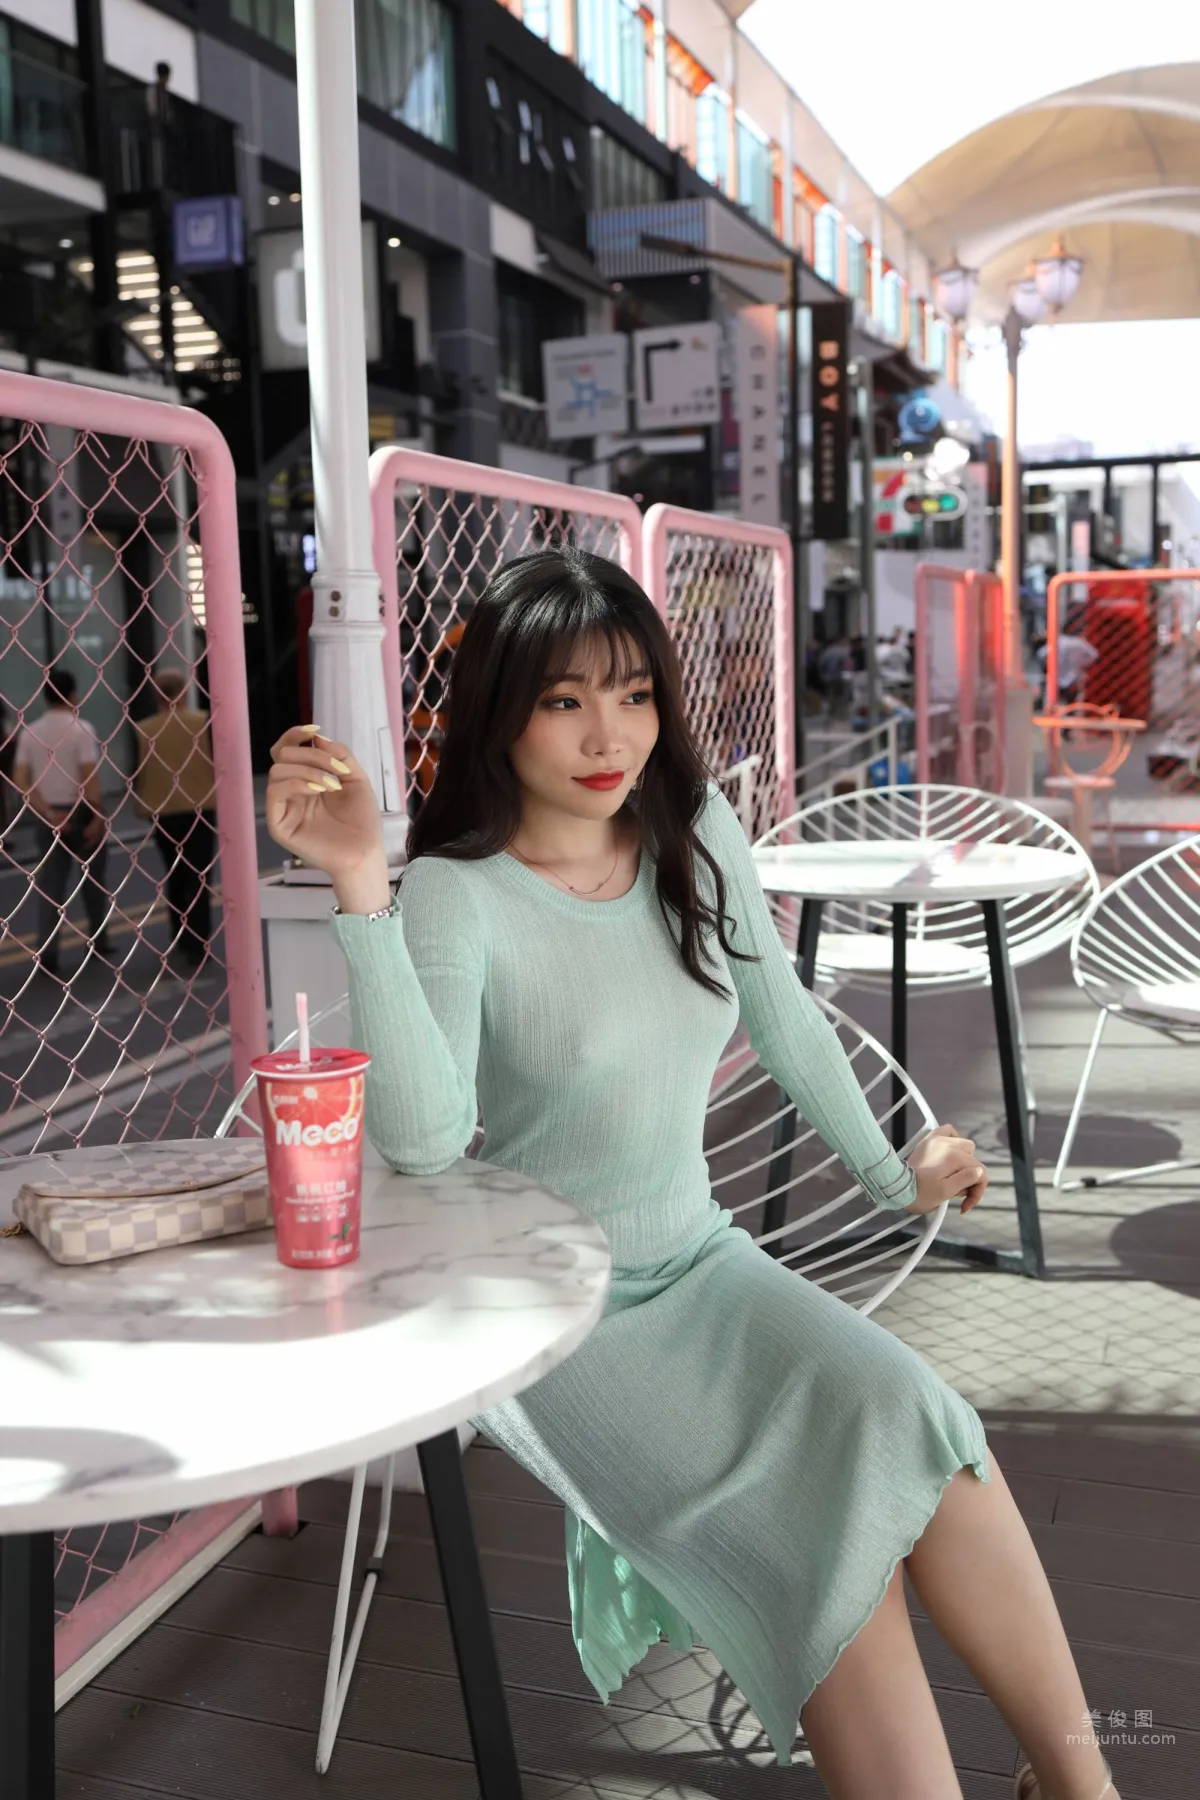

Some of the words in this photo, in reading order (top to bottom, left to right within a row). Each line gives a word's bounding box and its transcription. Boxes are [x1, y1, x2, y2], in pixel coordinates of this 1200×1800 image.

[818, 340, 840, 412] BOY
[750, 344, 769, 506] CHANEL
[275, 1117, 360, 1147] Meco
